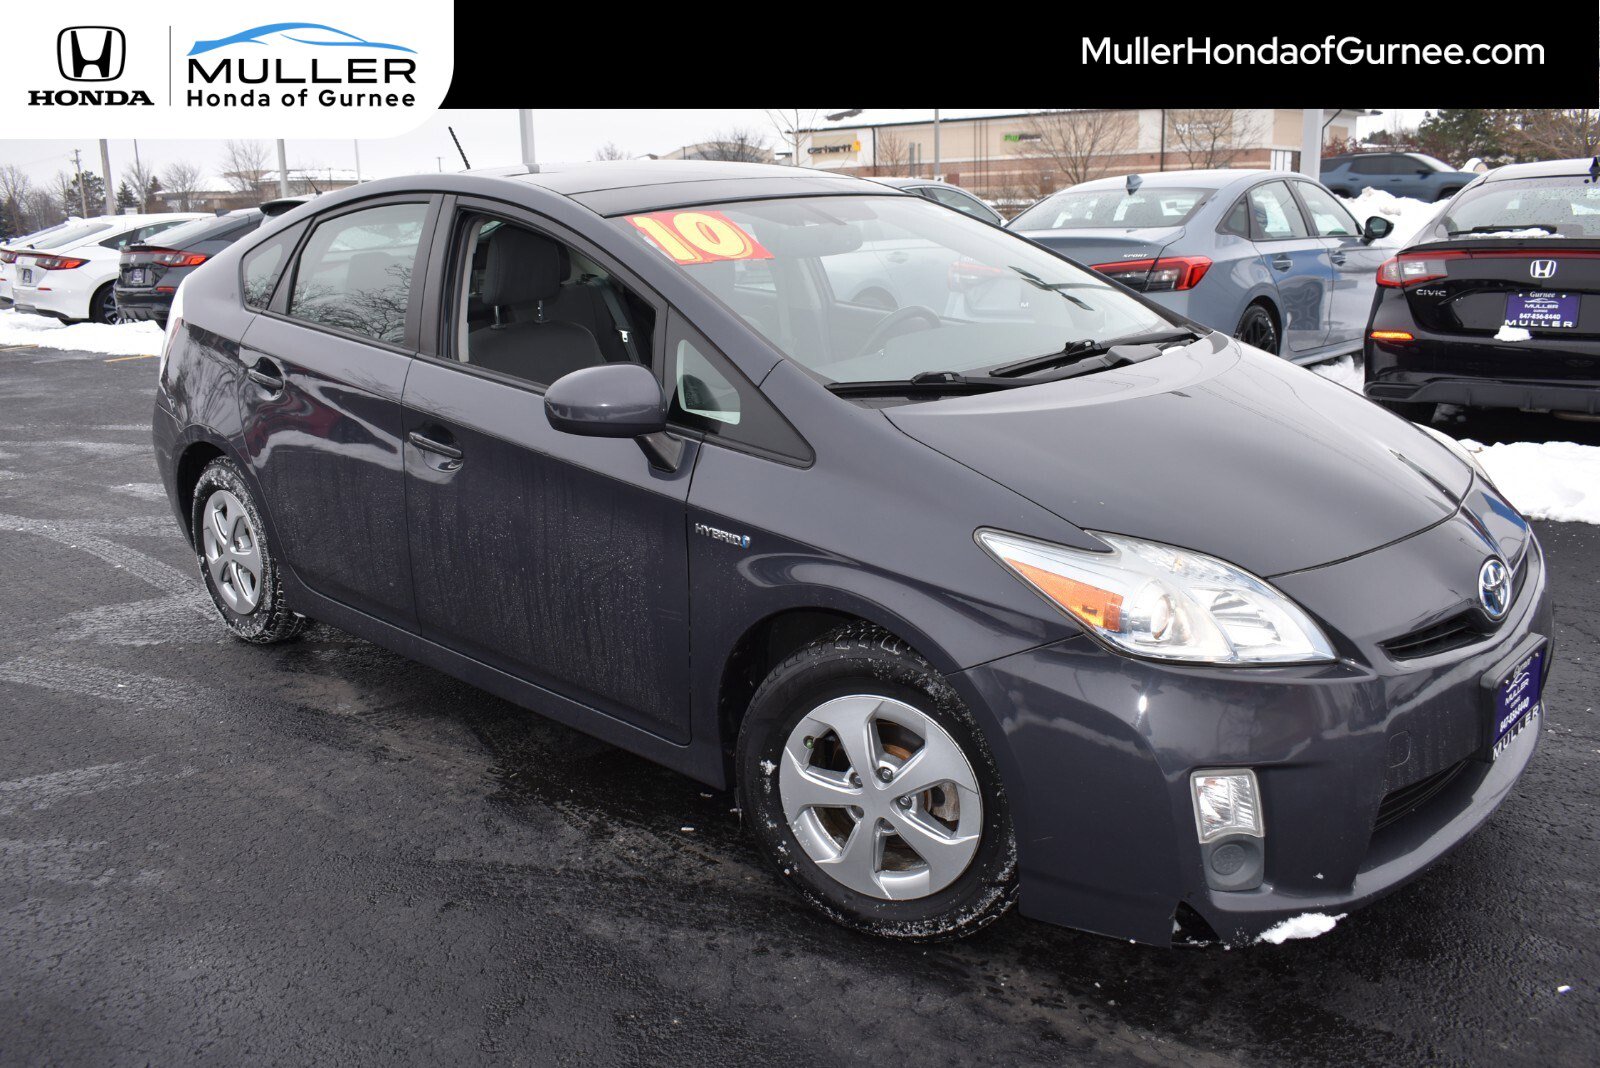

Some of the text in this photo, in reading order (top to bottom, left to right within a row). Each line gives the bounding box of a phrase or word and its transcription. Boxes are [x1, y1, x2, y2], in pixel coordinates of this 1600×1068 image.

[632, 212, 753, 261] 10
[1504, 320, 1573, 328] MULLER
[695, 522, 743, 547] HYBRID
[1492, 704, 1539, 761] MULLER
